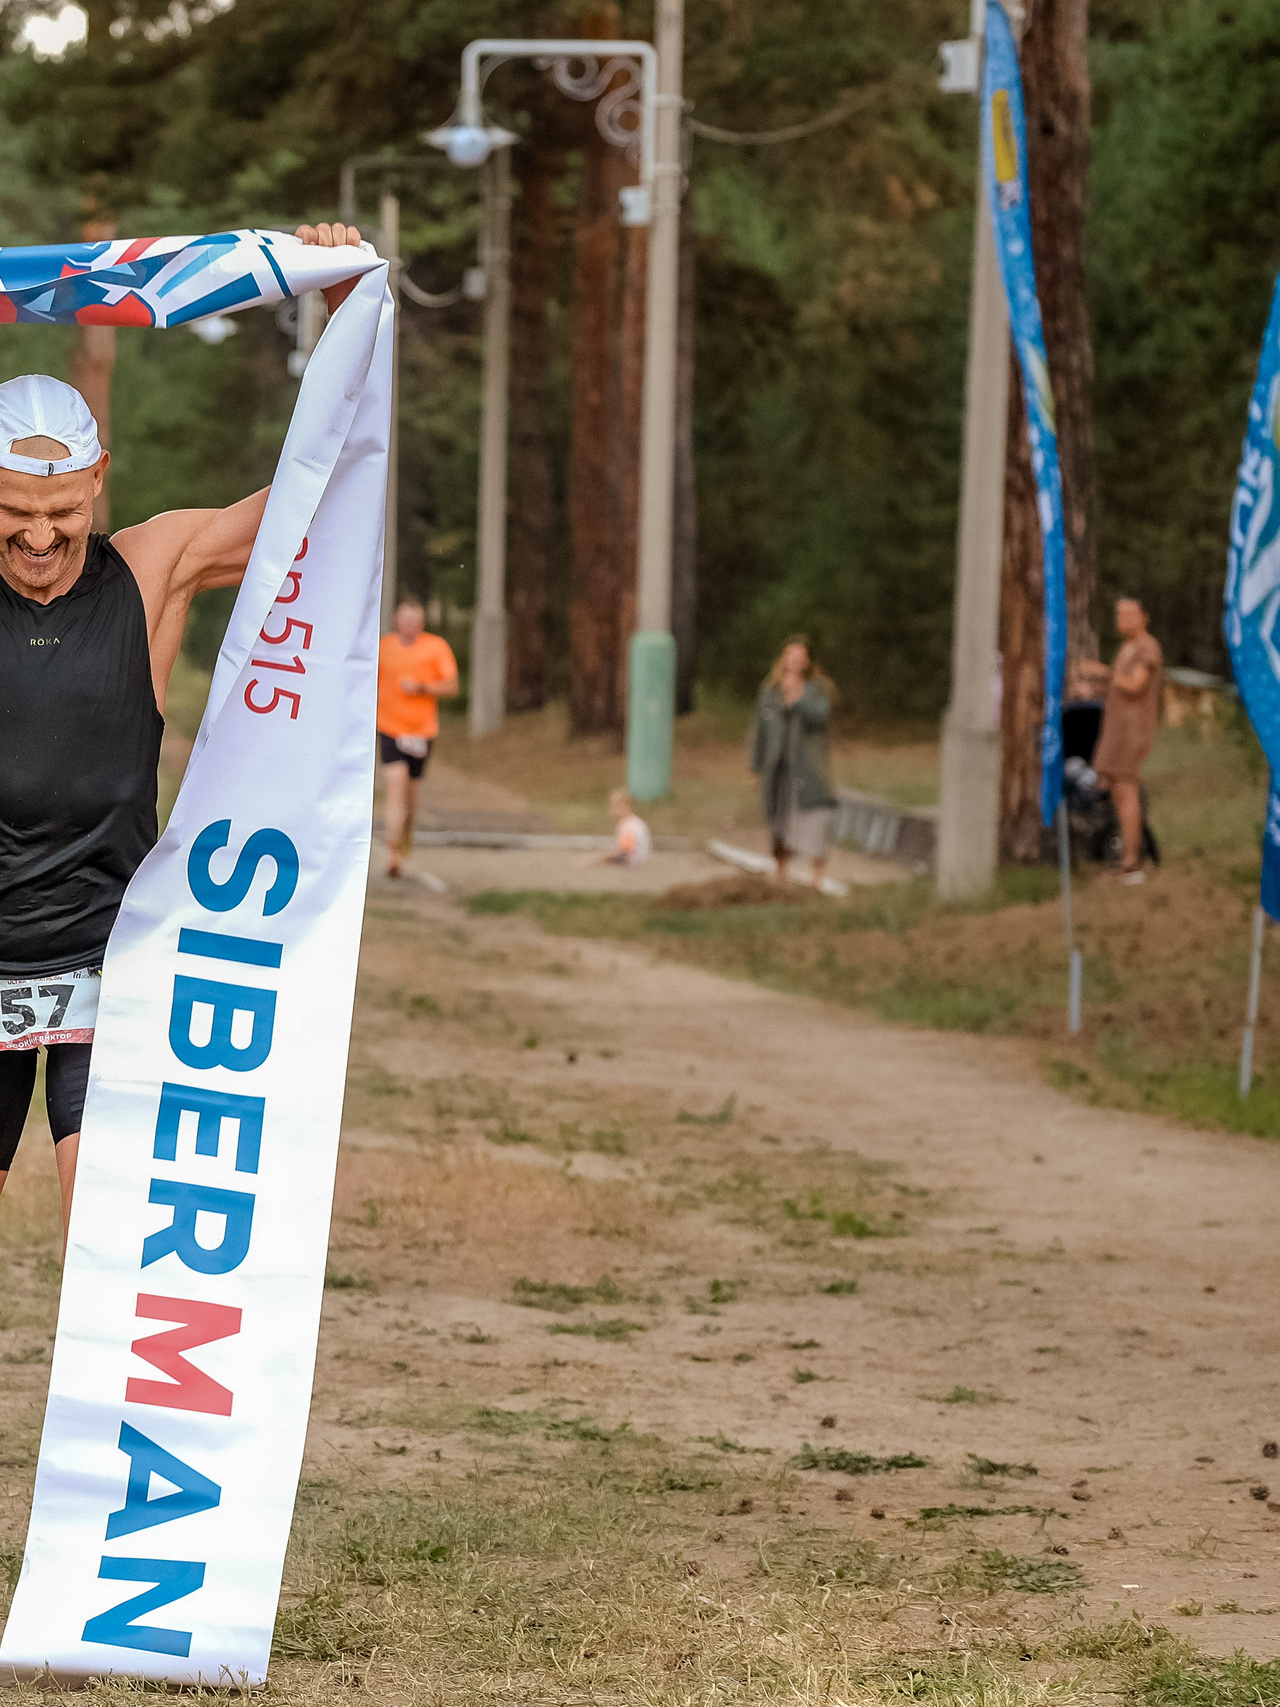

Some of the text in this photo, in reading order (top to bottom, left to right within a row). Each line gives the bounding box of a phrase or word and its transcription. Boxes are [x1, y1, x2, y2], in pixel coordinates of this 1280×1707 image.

[0, 984, 75, 1036] 57
[39, 1033, 72, 1043] ВИКТОР
[81, 818, 299, 1659] SIBERMAN
